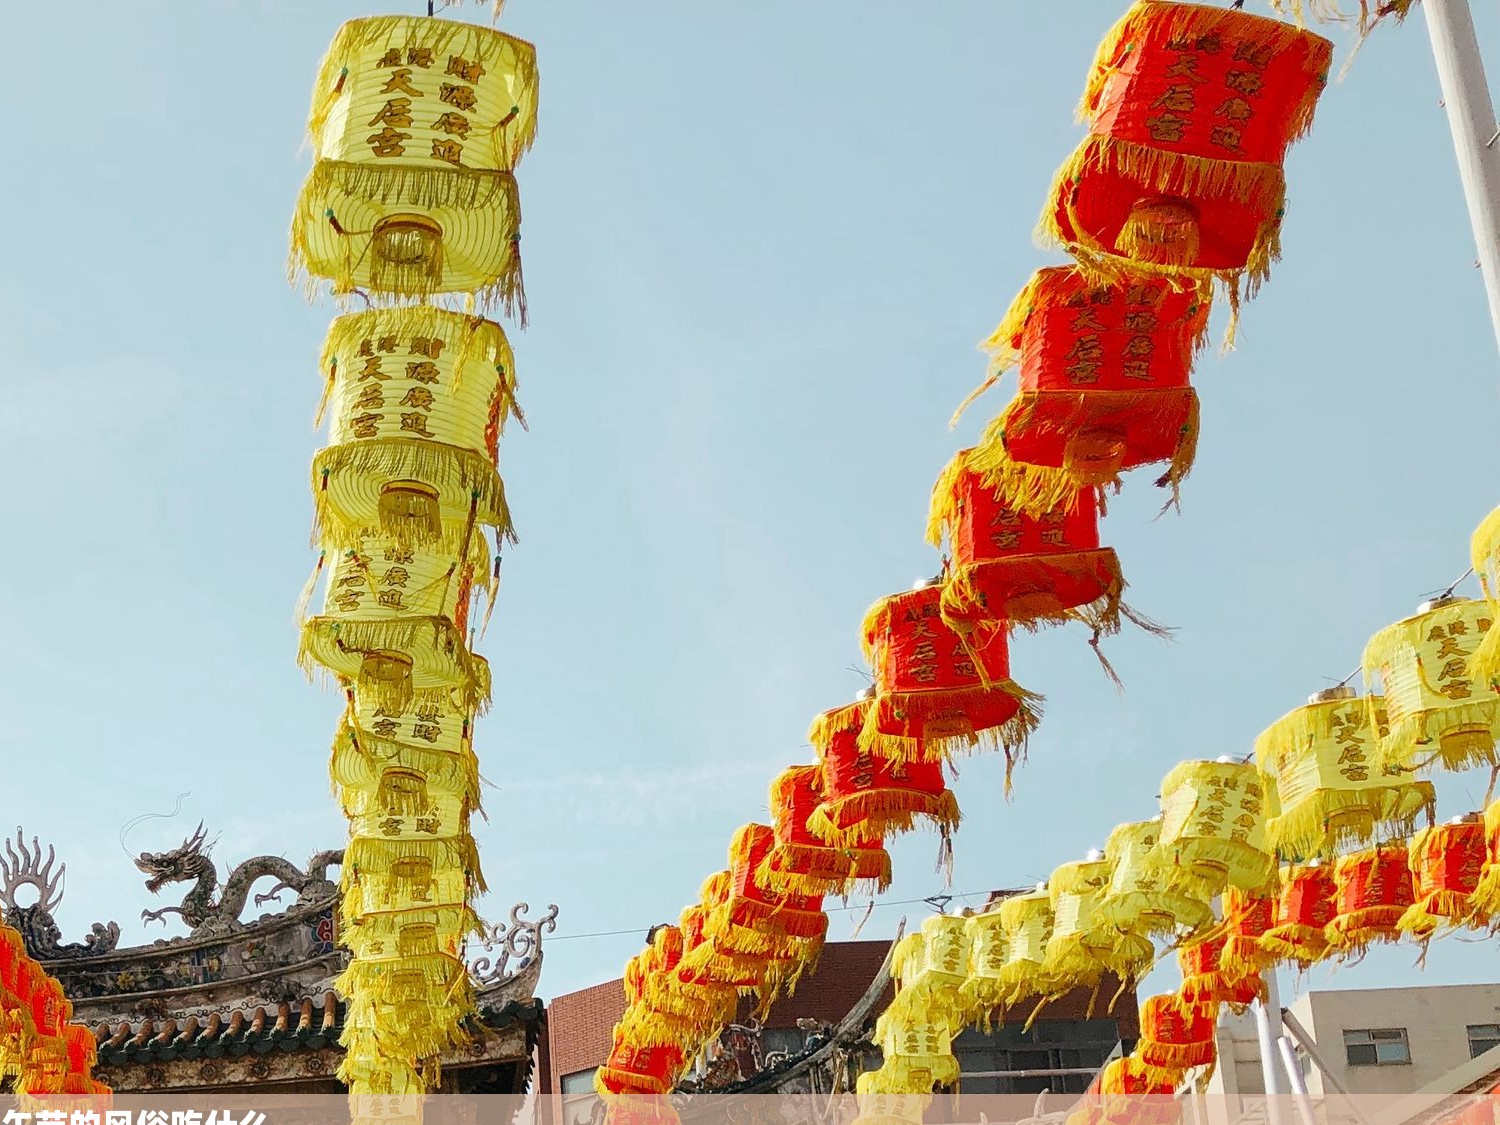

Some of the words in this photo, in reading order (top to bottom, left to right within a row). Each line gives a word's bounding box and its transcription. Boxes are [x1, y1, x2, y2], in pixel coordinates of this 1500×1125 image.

[429, 53, 486, 168] 財源廣進
[398, 335, 447, 438] 財源廣進
